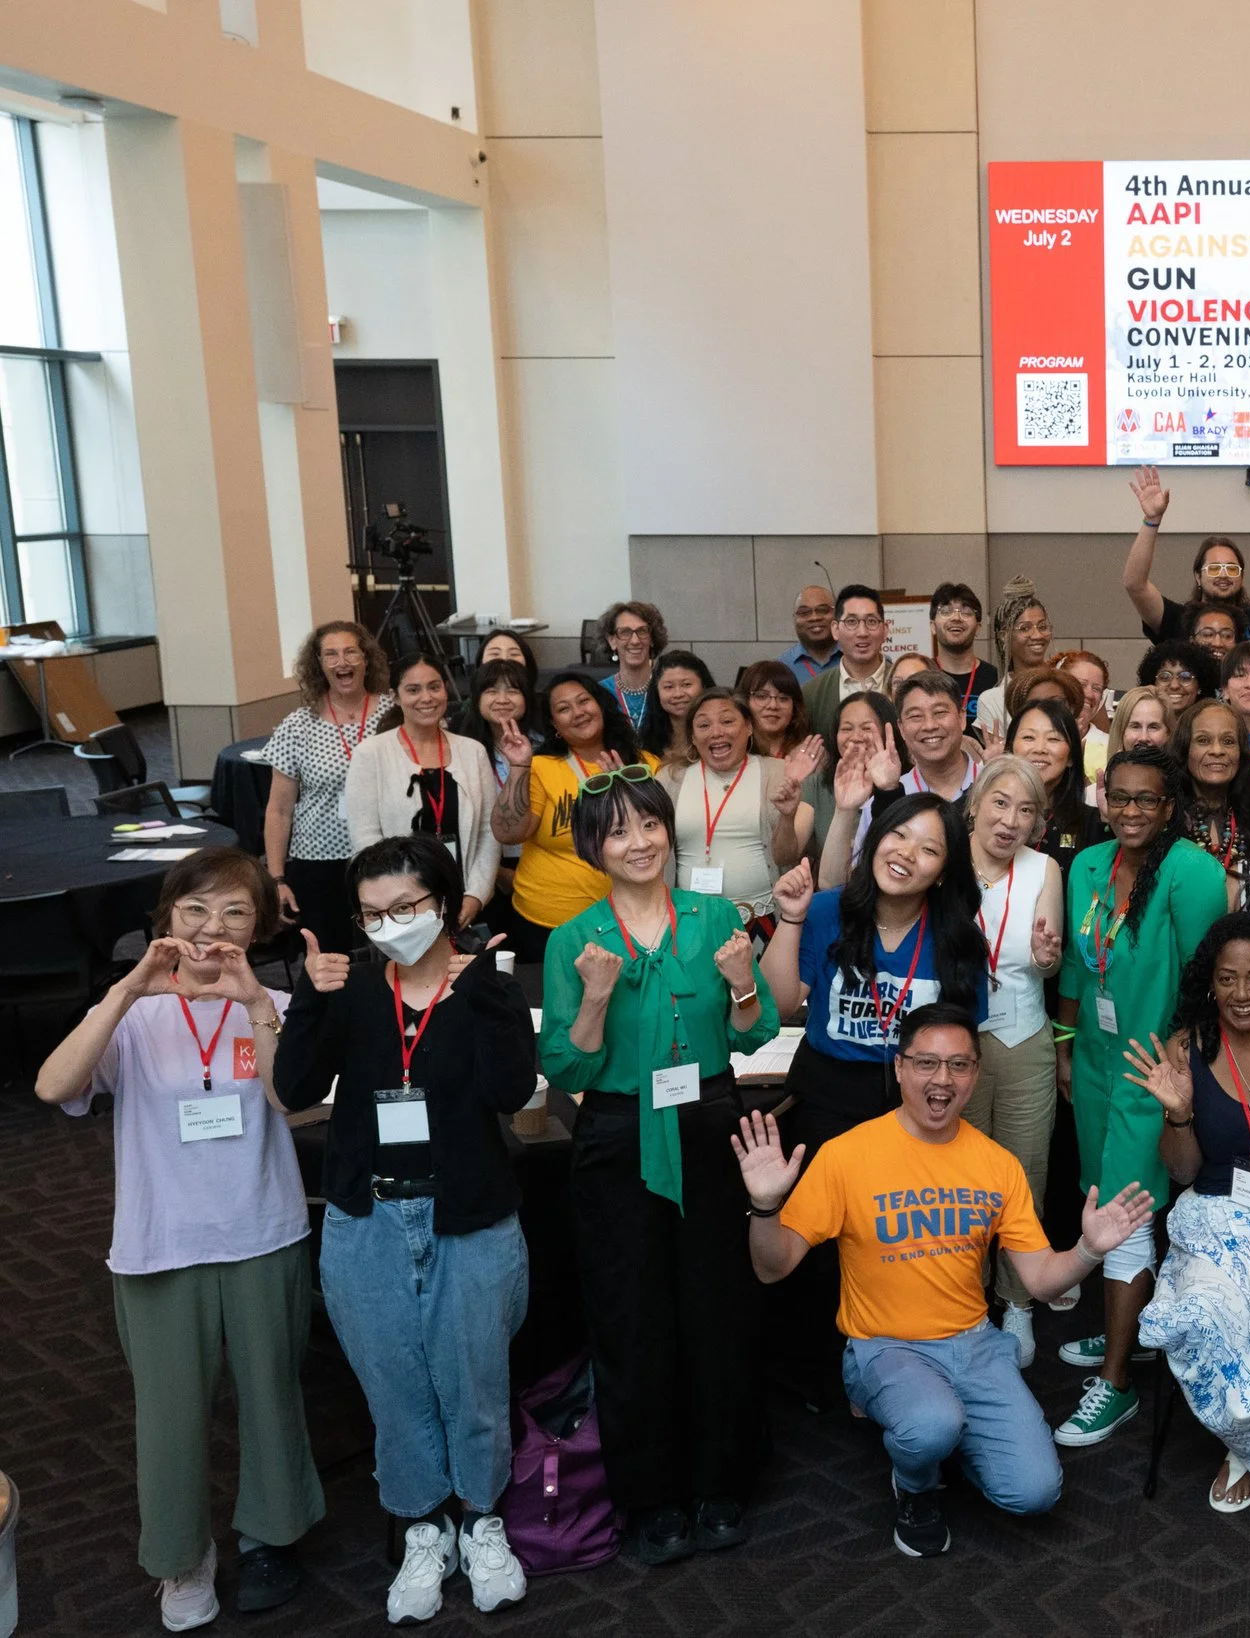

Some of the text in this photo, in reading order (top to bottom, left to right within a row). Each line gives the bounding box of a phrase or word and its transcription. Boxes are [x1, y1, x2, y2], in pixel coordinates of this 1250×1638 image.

[1125, 175, 1167, 196] 4th
[995, 208, 1099, 224] WEDNESDAY
[1126, 202, 1201, 225] AAPI
[1023, 229, 1072, 250] July 2
[1127, 267, 1196, 290] GUN
[1019, 356, 1084, 368] PROGRAM
[1126, 354, 1161, 372] July
[1169, 355, 1180, 368] 1
[1199, 355, 1216, 371] 2,
[1127, 372, 1217, 383] Kasbeer Hall
[1127, 386, 1171, 399] Loyola
[1177, 386, 1250, 399] University,
[1154, 411, 1187, 433] CAA
[1192, 425, 1228, 435] BRADY
[883, 644, 918, 652] OLENCE
[837, 1017, 891, 1040] LIVES
[873, 1187, 1003, 1212] TEACHERS
[875, 1208, 999, 1245] UNIFY
[881, 1255, 896, 1263] TO
[900, 1250, 925, 1262] END
[929, 1246, 952, 1257] GUN
